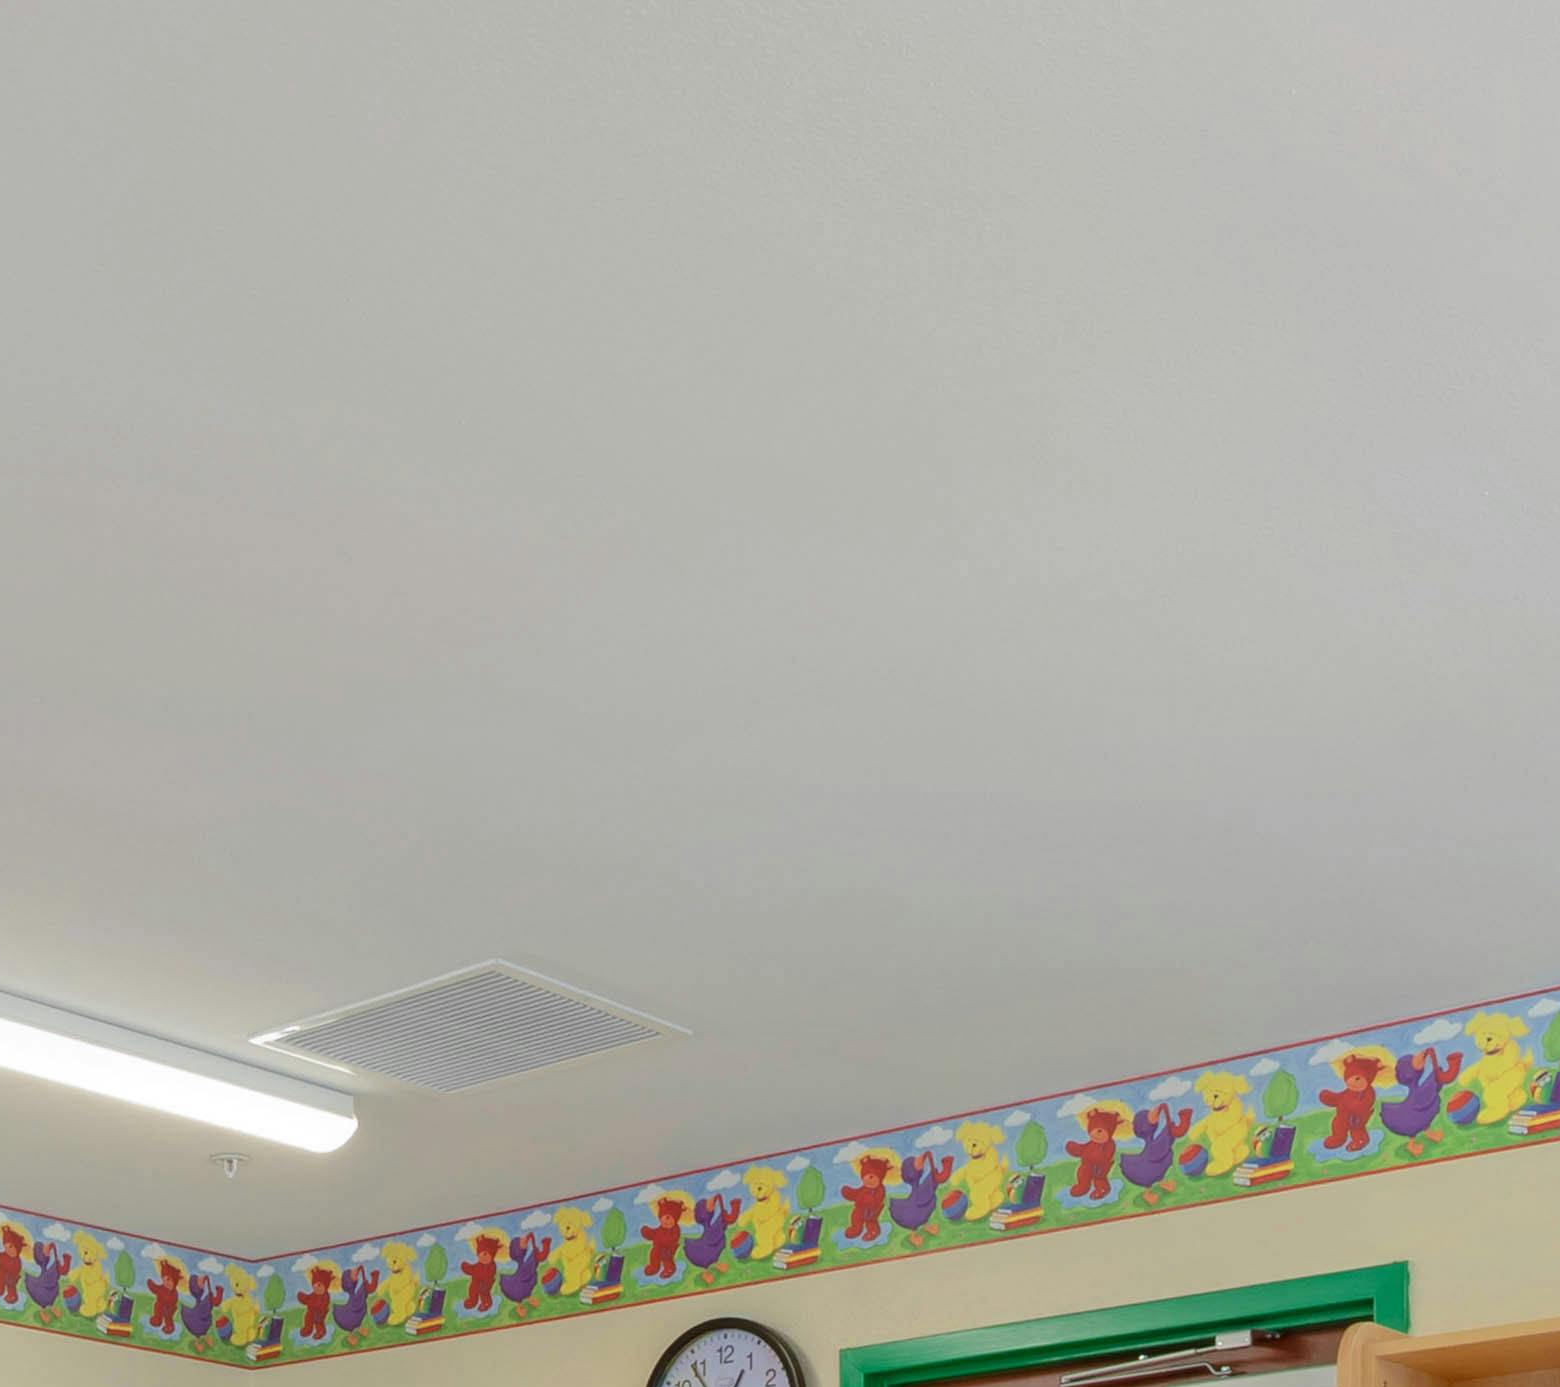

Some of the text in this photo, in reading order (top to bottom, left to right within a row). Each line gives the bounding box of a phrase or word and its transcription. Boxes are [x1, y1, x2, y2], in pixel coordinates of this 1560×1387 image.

[717, 1345, 735, 1364] 12
[746, 1352, 753, 1370] 1
[765, 1369, 776, 1387] 2
